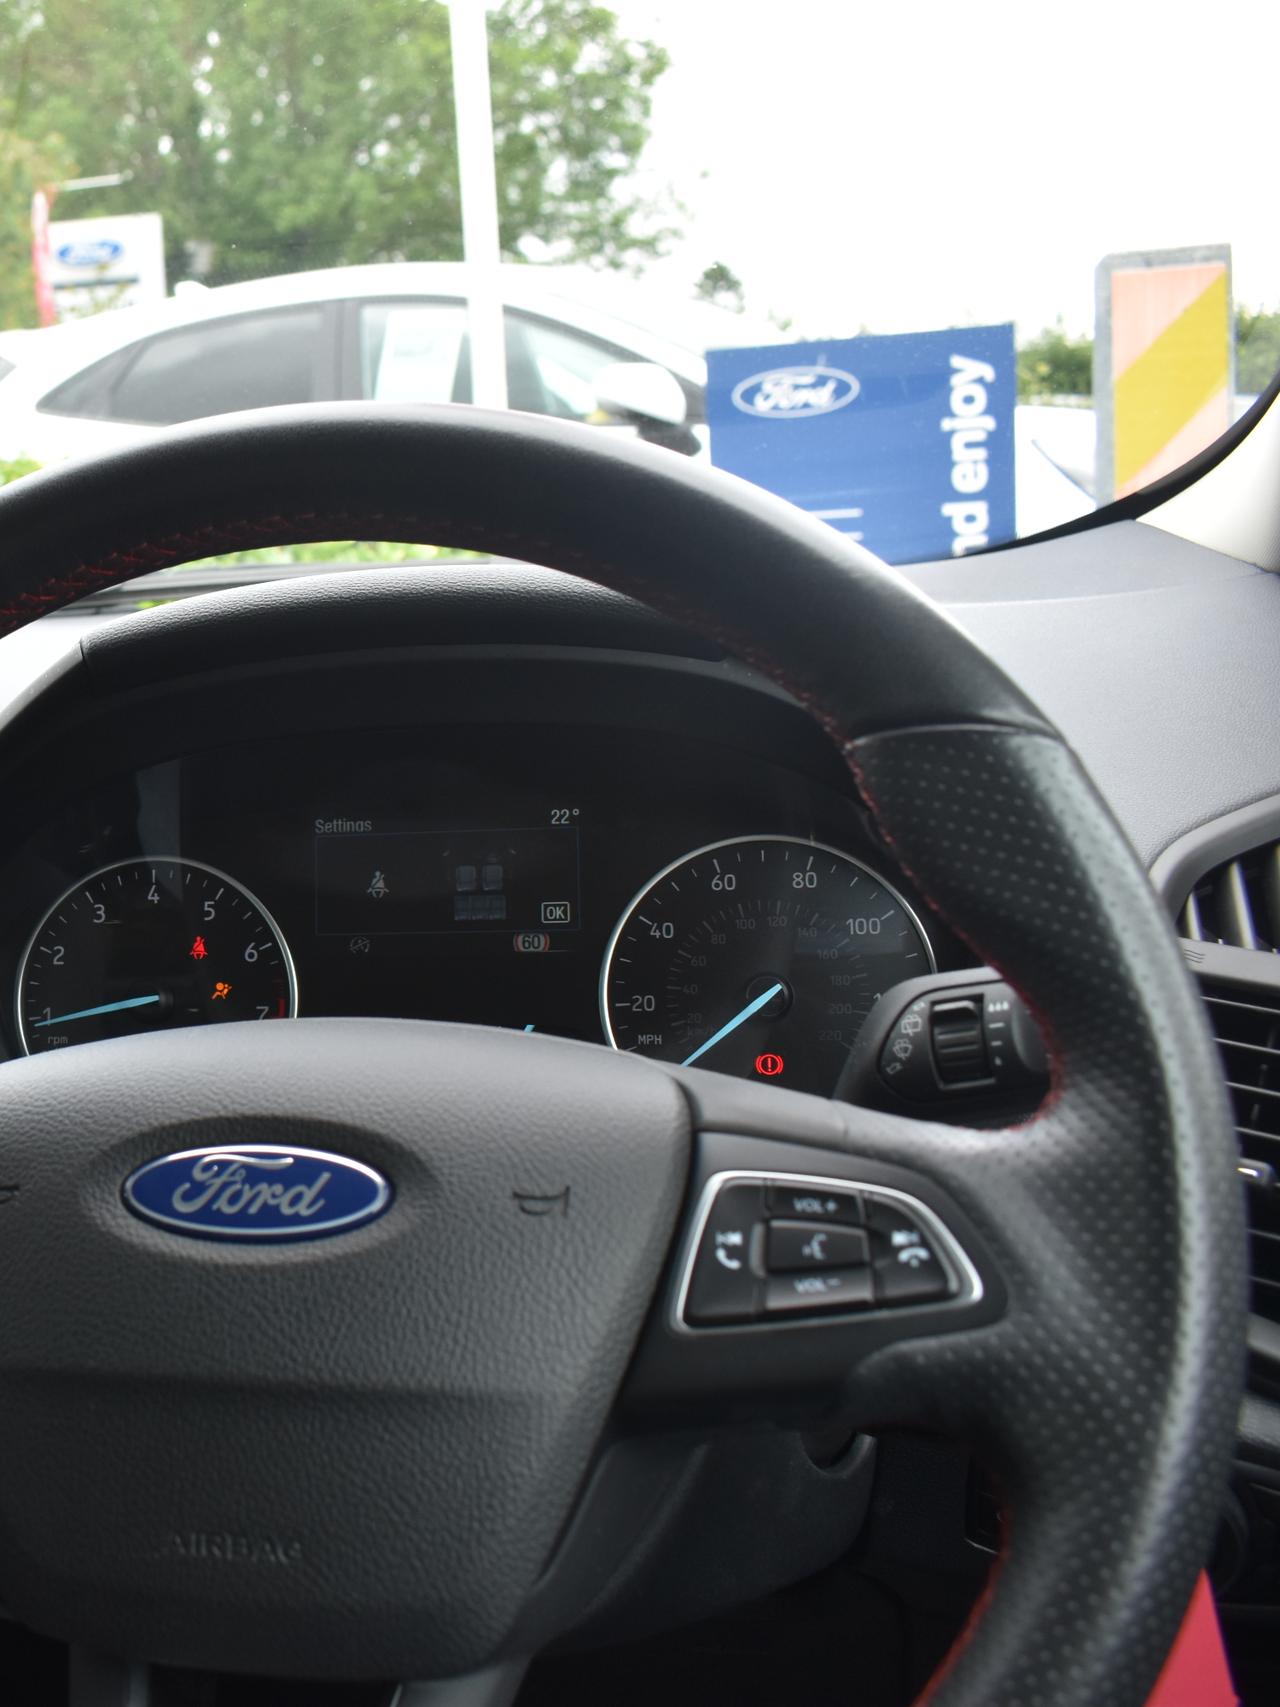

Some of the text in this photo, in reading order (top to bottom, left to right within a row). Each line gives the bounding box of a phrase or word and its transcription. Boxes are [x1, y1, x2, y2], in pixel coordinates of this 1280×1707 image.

[753, 373, 838, 412] Ford
[940, 354, 997, 494] enjoy
[711, 874, 736, 891] 60
[792, 872, 817, 889] 80
[147, 885, 160, 904] 4
[93, 904, 106, 923] 3
[204, 901, 215, 920] 5
[545, 906, 565, 919] OK
[650, 922, 674, 939] 40
[846, 918, 881, 935] 100
[522, 934, 541, 950] 60
[53, 946, 65, 965] 2
[244, 942, 258, 962] 6
[632, 995, 655, 1011] 20
[256, 1006, 269, 1020] 7
[48, 1035, 69, 1046] rpm
[638, 1035, 662, 1045] MPH
[172, 1153, 331, 1217] Ford
